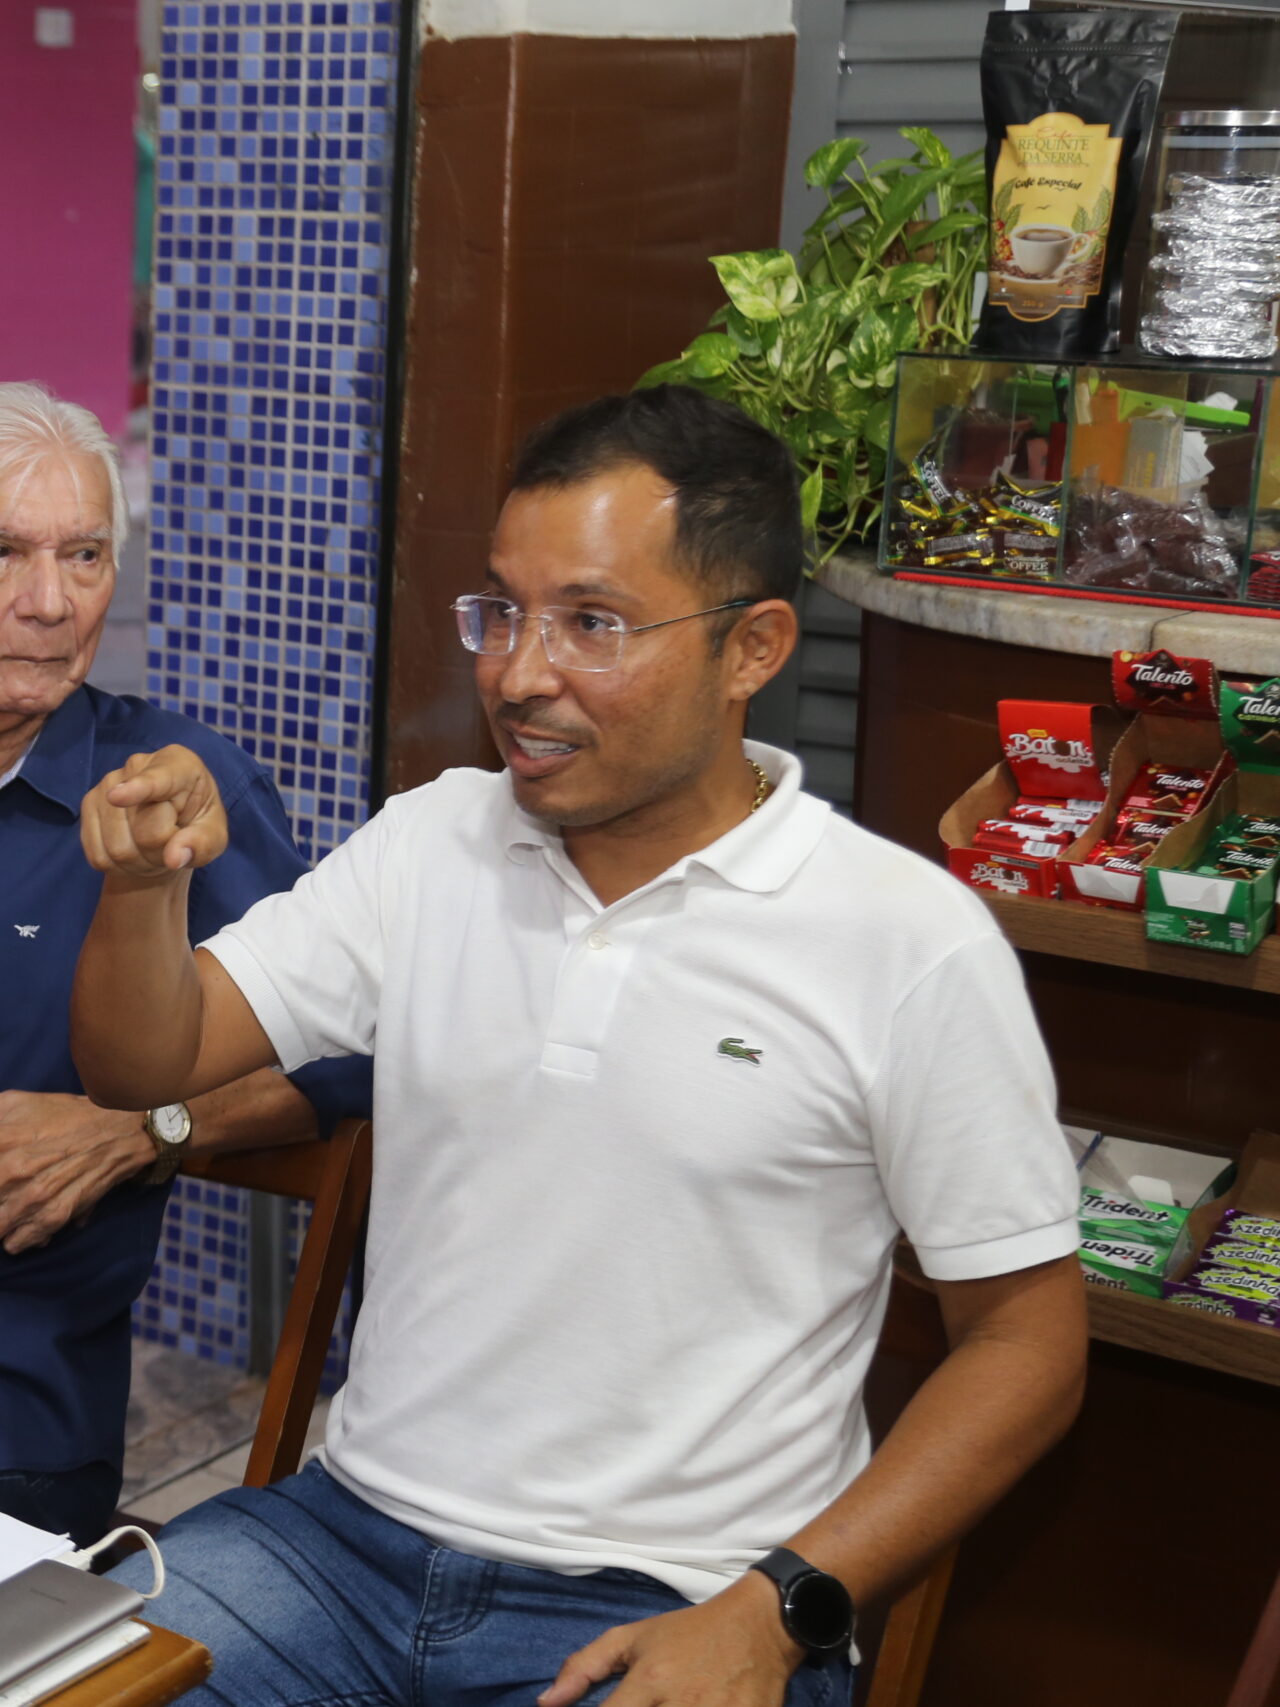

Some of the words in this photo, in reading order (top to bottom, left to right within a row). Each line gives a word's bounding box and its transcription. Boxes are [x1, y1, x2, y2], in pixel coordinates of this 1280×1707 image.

[1018, 139, 1089, 152] REQUINTE
[1023, 152, 1040, 163] DA
[1044, 152, 1083, 163] SERRA
[1015, 178, 1035, 189] Café
[1037, 178, 1082, 190] Especial
[1131, 664, 1193, 686] Talento
[1156, 774, 1204, 789] Talento
[1084, 1194, 1169, 1220] Trident
[1203, 1275, 1279, 1295] Azedinha
